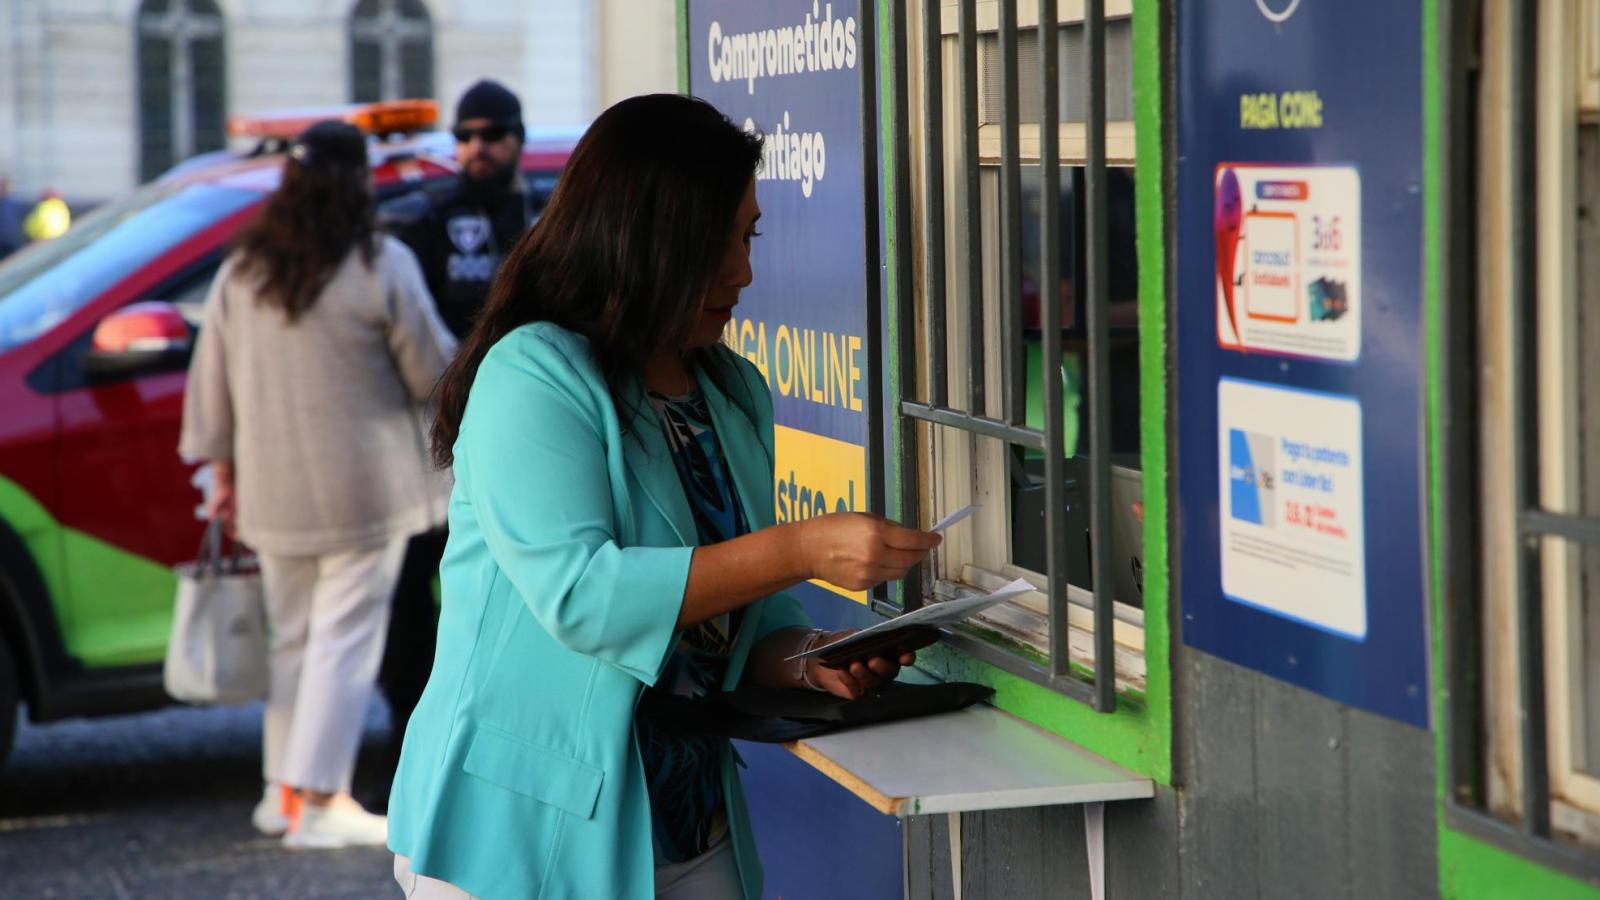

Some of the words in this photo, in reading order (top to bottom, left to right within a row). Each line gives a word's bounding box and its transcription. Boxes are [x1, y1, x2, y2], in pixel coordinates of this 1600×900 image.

[708, 0, 857, 95] Comprometidos
[743, 110, 826, 198] antiago
[1240, 93, 1279, 129] PAGA
[722, 316, 772, 390] AGA
[775, 323, 863, 412] ONLINE
